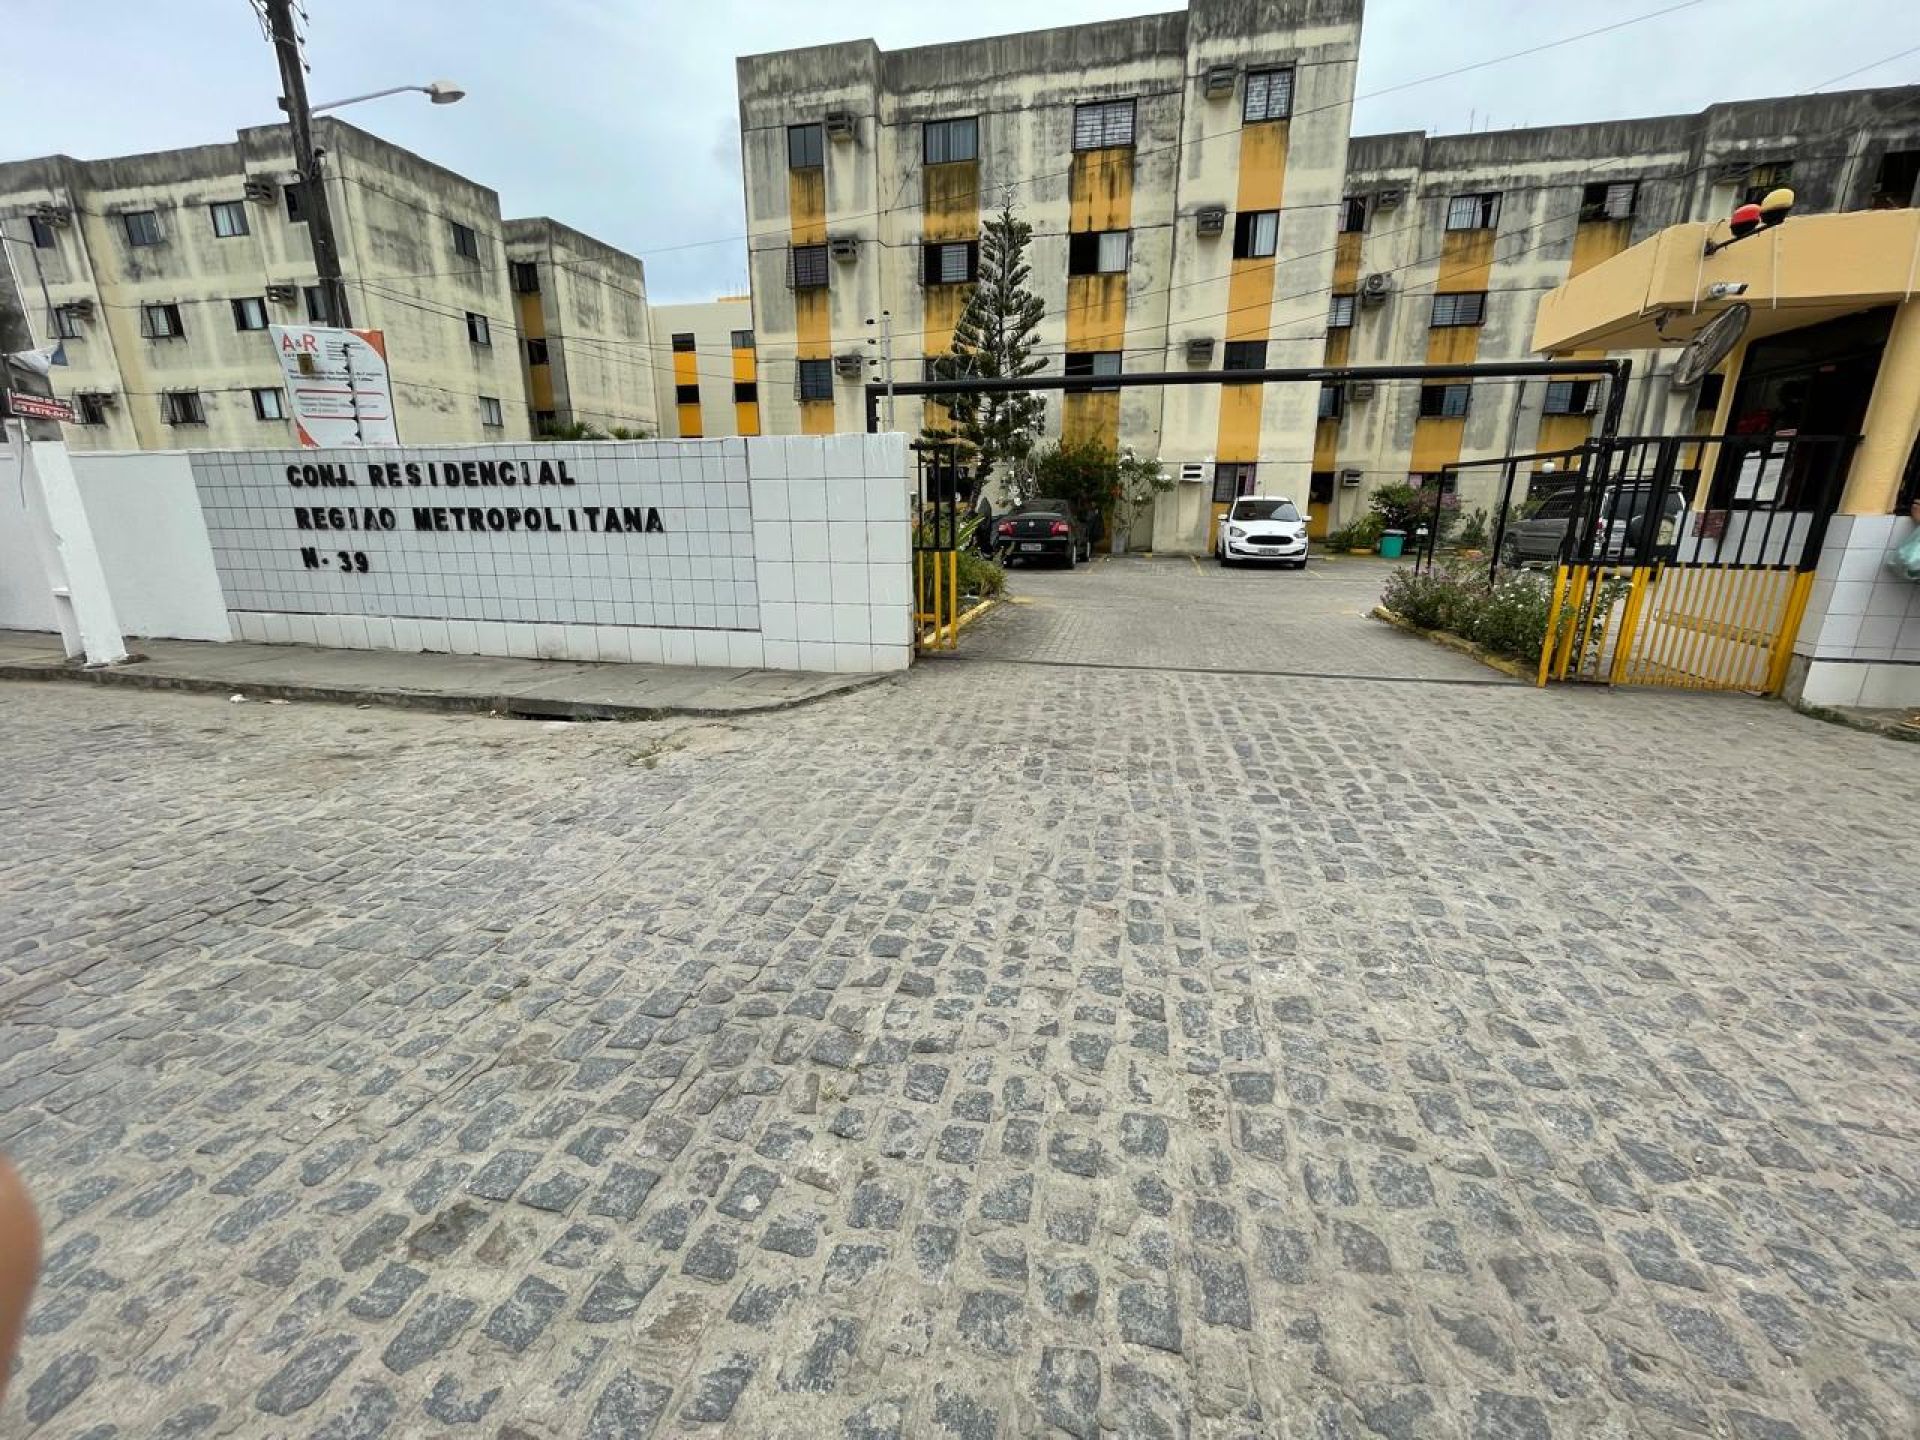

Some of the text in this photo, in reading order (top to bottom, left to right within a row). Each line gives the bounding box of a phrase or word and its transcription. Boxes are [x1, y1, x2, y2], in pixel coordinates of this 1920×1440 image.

[282, 332, 319, 352] A&R
[286, 460, 576, 489] CONJ. RESIDENCIAL
[293, 506, 664, 534] REGIAO METROPOLITANA
[336, 551, 369, 574] 39
